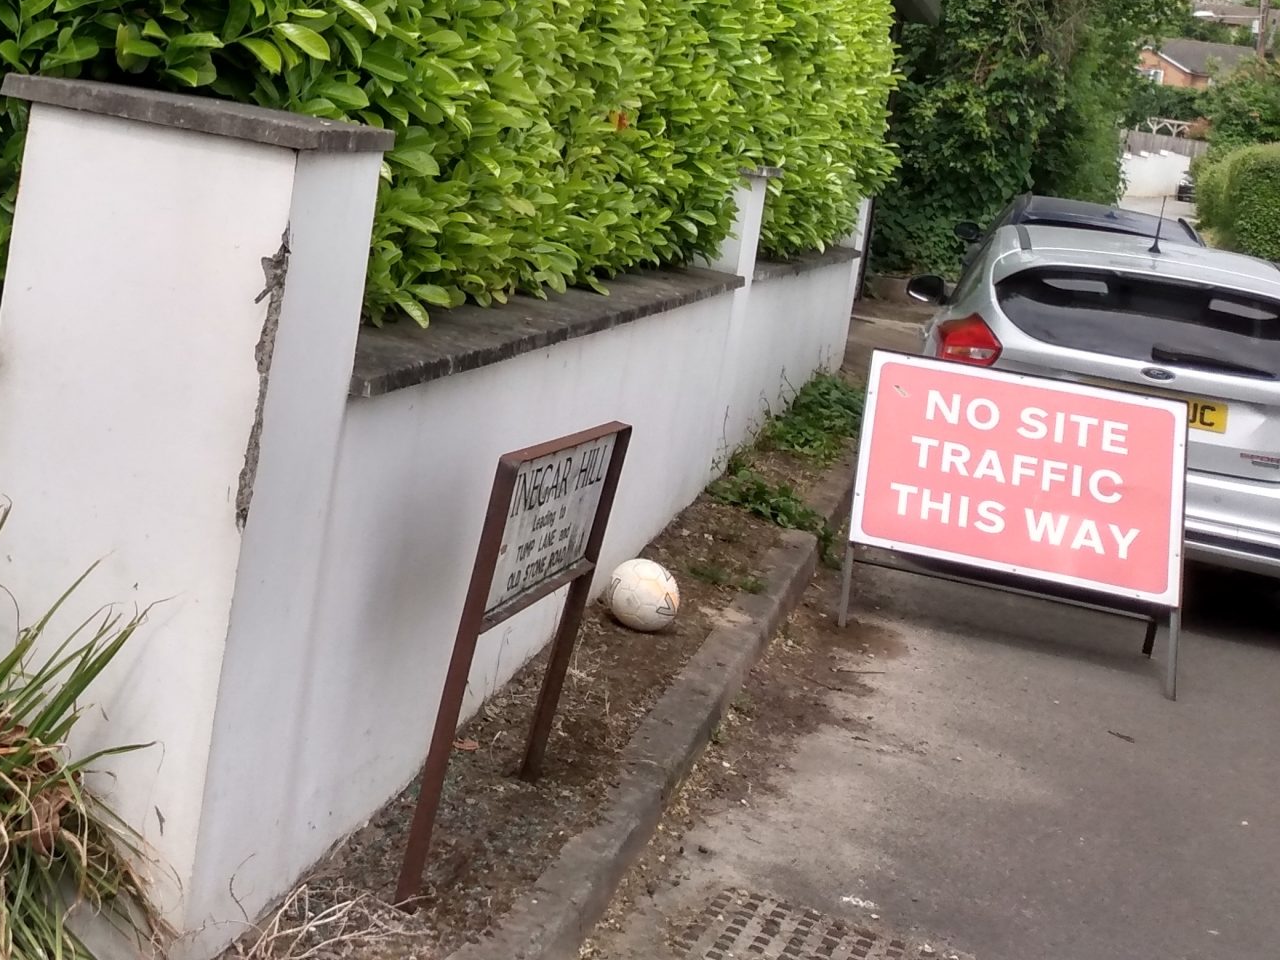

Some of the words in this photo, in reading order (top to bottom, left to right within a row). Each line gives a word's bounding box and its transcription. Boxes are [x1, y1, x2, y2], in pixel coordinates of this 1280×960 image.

[926, 390, 1000, 430] NO
[1016, 406, 1129, 455] SITE
[510, 457, 572, 518] INEGAR
[575, 445, 607, 491] HILL
[911, 436, 1124, 504] TRAFFIC
[532, 510, 556, 531] Leading
[559, 504, 566, 520] to
[538, 529, 557, 552] LANE
[890, 482, 1006, 534] THIS
[1025, 507, 1140, 559] WAY
[507, 570, 521, 591] OLD
